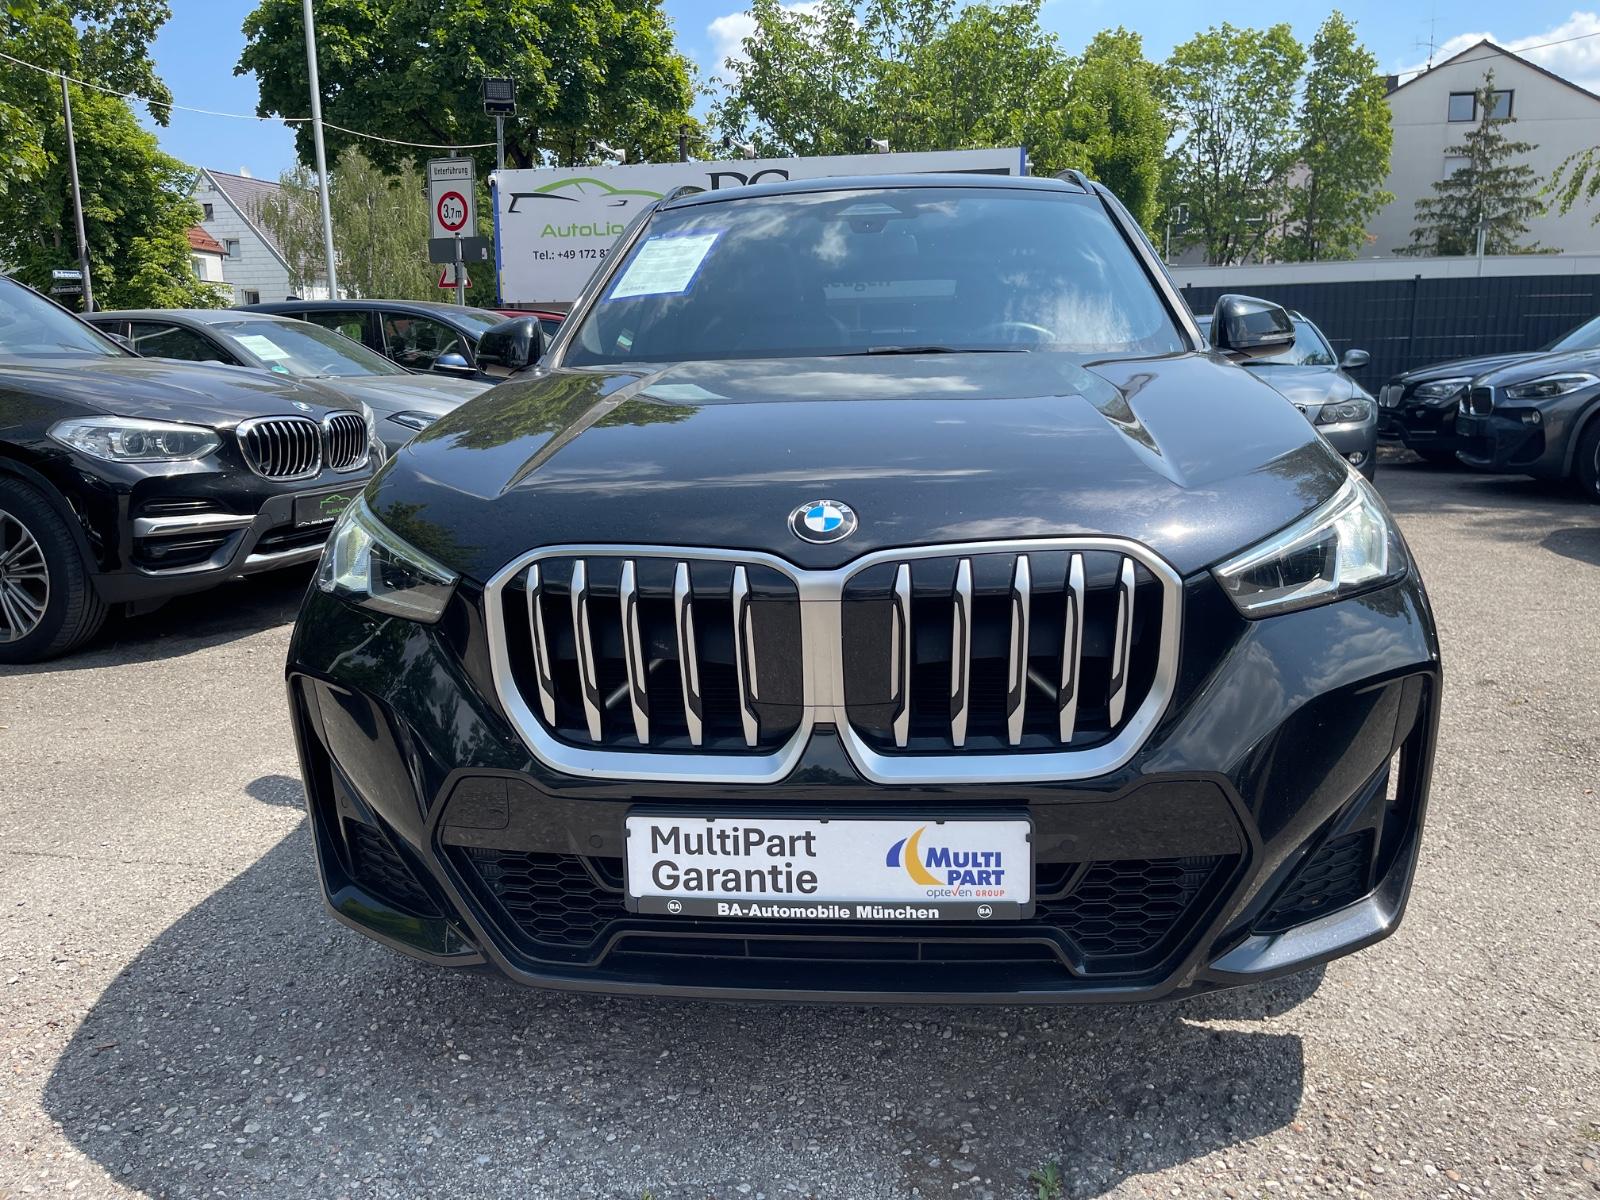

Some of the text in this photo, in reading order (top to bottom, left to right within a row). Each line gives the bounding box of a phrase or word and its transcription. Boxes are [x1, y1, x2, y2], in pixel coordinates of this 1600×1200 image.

[533, 250, 554, 260] Tel.:
[557, 249, 576, 259] +49
[579, 249, 597, 259] 172
[650, 825, 817, 857] MultiPart
[651, 859, 818, 894] Garantie
[947, 869, 1005, 886] PART
[975, 889, 1005, 897] GROUP
[668, 902, 681, 911] BA
[717, 902, 940, 919] BA-Automobile München
[978, 906, 992, 916] BA
